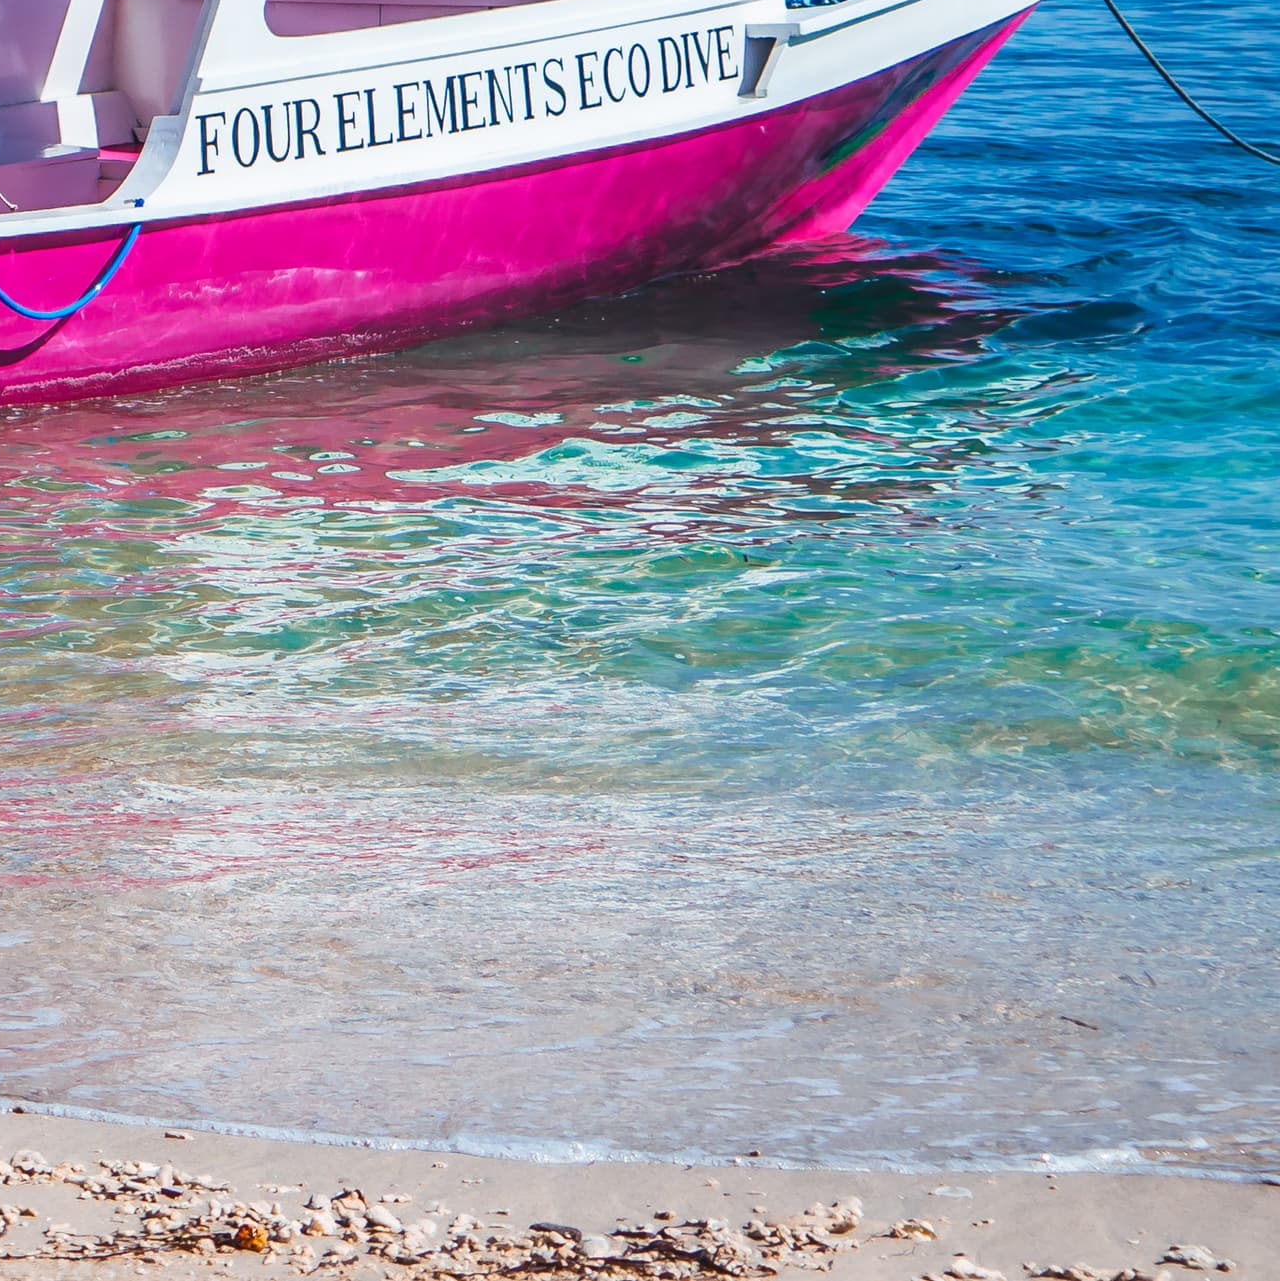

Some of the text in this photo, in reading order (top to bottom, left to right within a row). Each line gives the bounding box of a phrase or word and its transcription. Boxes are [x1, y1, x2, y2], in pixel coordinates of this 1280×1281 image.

[195, 24, 740, 176] FOUR ELEMENTS ECO DIVE
